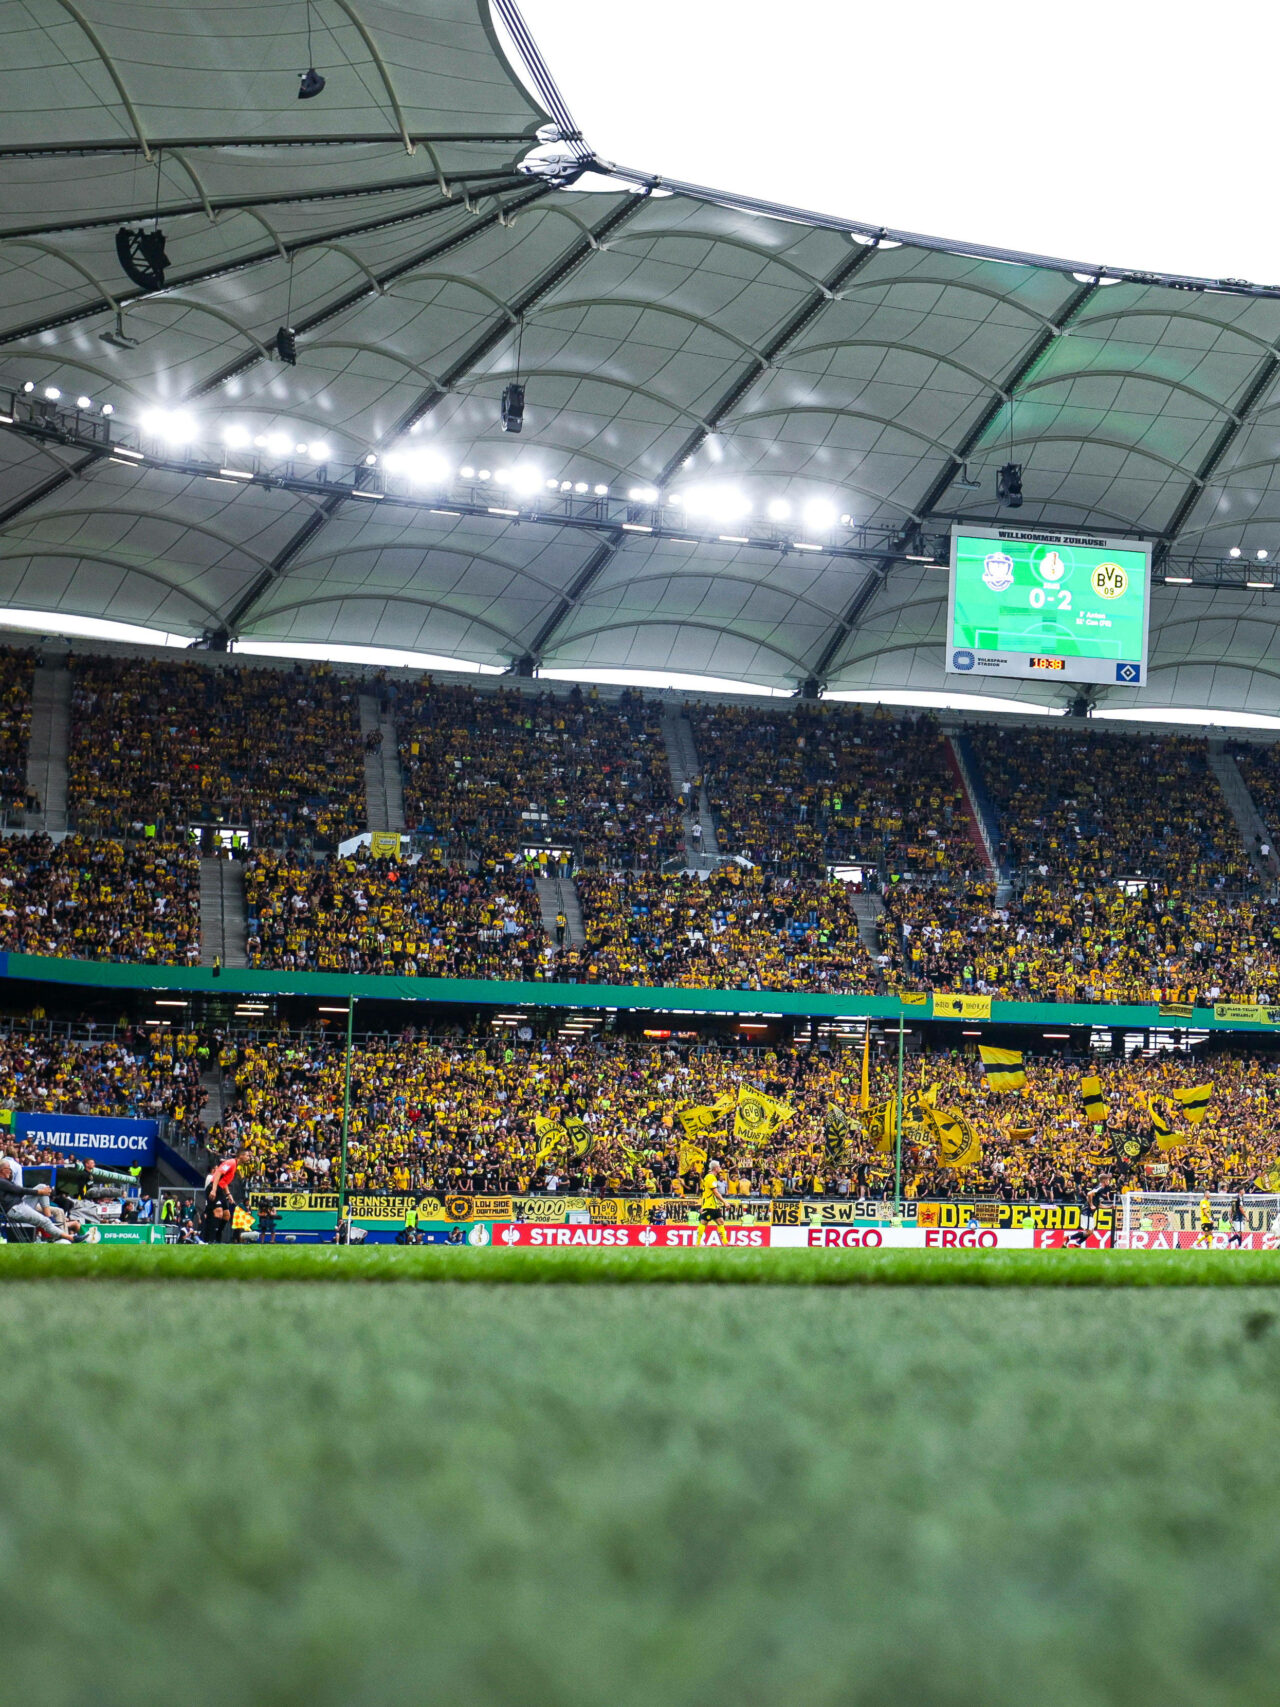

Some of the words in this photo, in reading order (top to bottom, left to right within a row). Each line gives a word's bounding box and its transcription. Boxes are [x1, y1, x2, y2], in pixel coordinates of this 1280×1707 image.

[998, 531, 1061, 543] WILLKOMMEN
[1063, 536, 1107, 547] ZUHAUSE!
[1097, 567, 1123, 588] BVB
[349, 1196, 416, 1208] RENNSTEIG
[422, 1199, 439, 1212] BVB
[524, 1199, 565, 1215] CODO
[602, 1202, 616, 1213] BVB
[773, 1202, 799, 1210] SUPPS
[351, 1208, 410, 1218] BORUSSE
[773, 1210, 798, 1224] MS
[940, 1203, 1112, 1230] DEPERADS
[531, 1228, 628, 1245] STRAUSS
[808, 1229, 882, 1247] ERGO
[926, 1230, 997, 1248] ERGO
